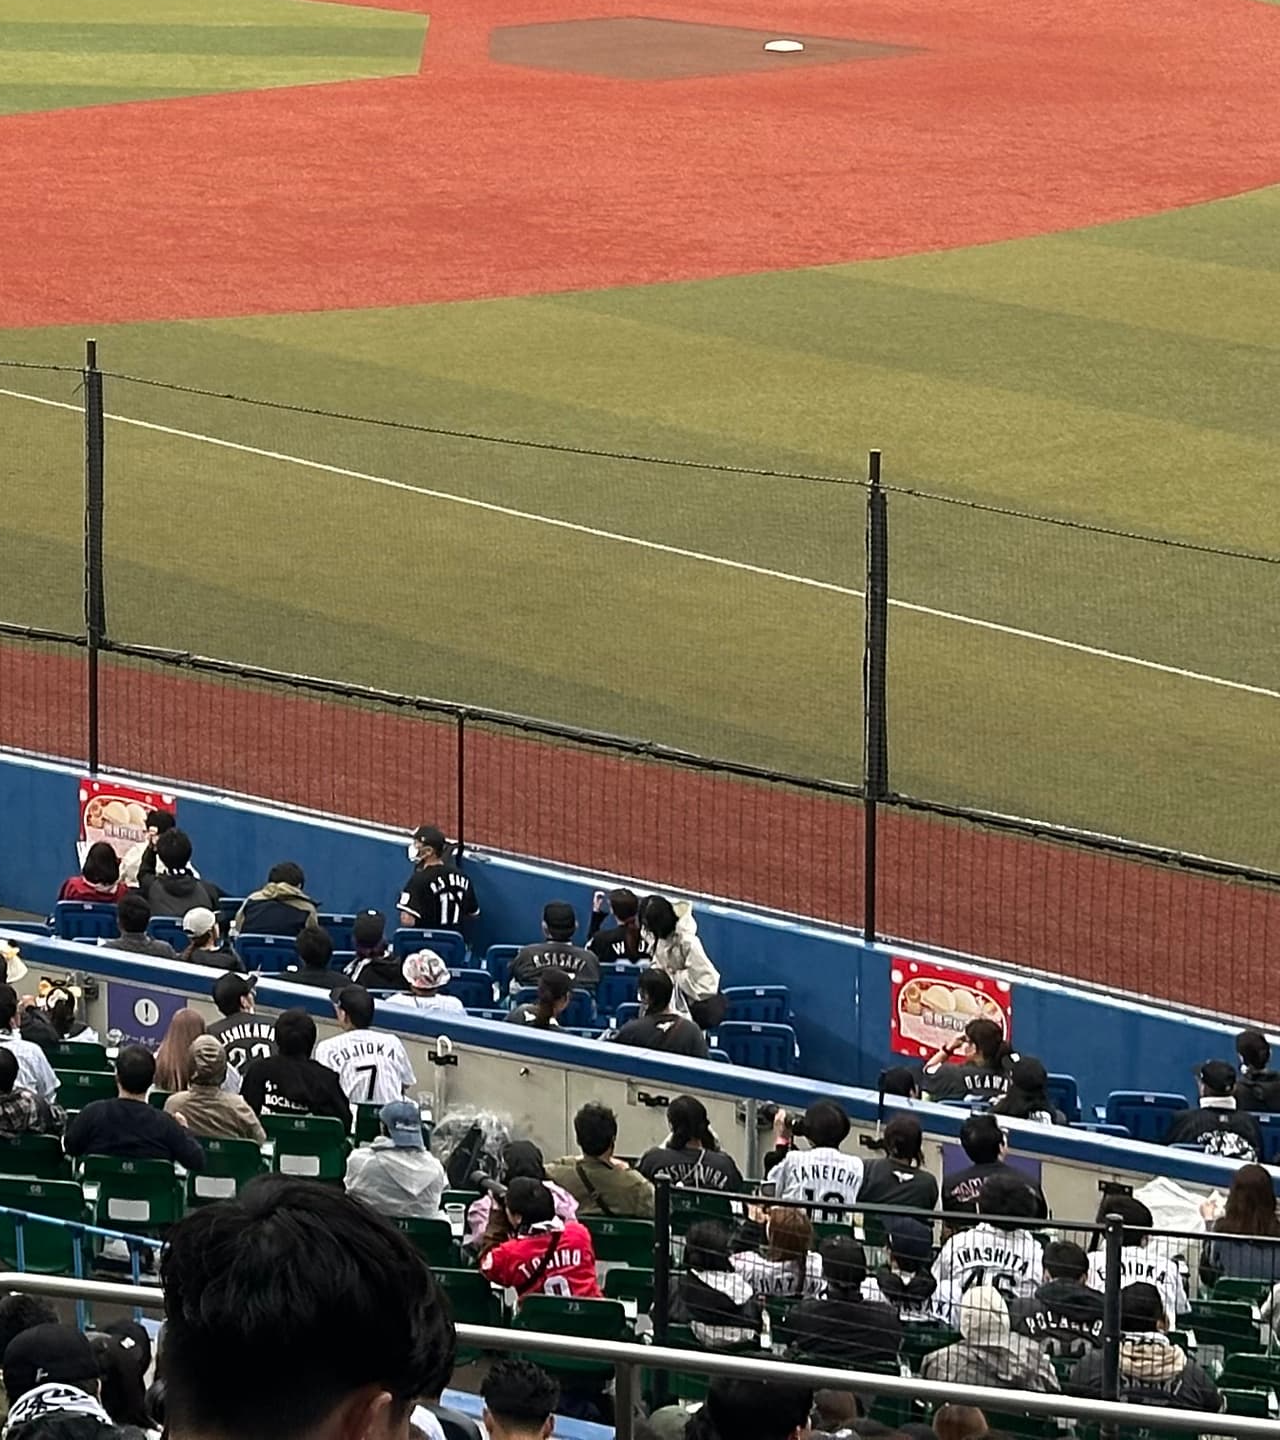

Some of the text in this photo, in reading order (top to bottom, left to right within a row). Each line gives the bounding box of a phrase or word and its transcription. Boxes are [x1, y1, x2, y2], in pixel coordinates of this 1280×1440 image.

[334, 1041, 396, 1067] FUJIOKA
[355, 1063, 378, 1102] 7
[791, 1163, 861, 1189] TANEICHI
